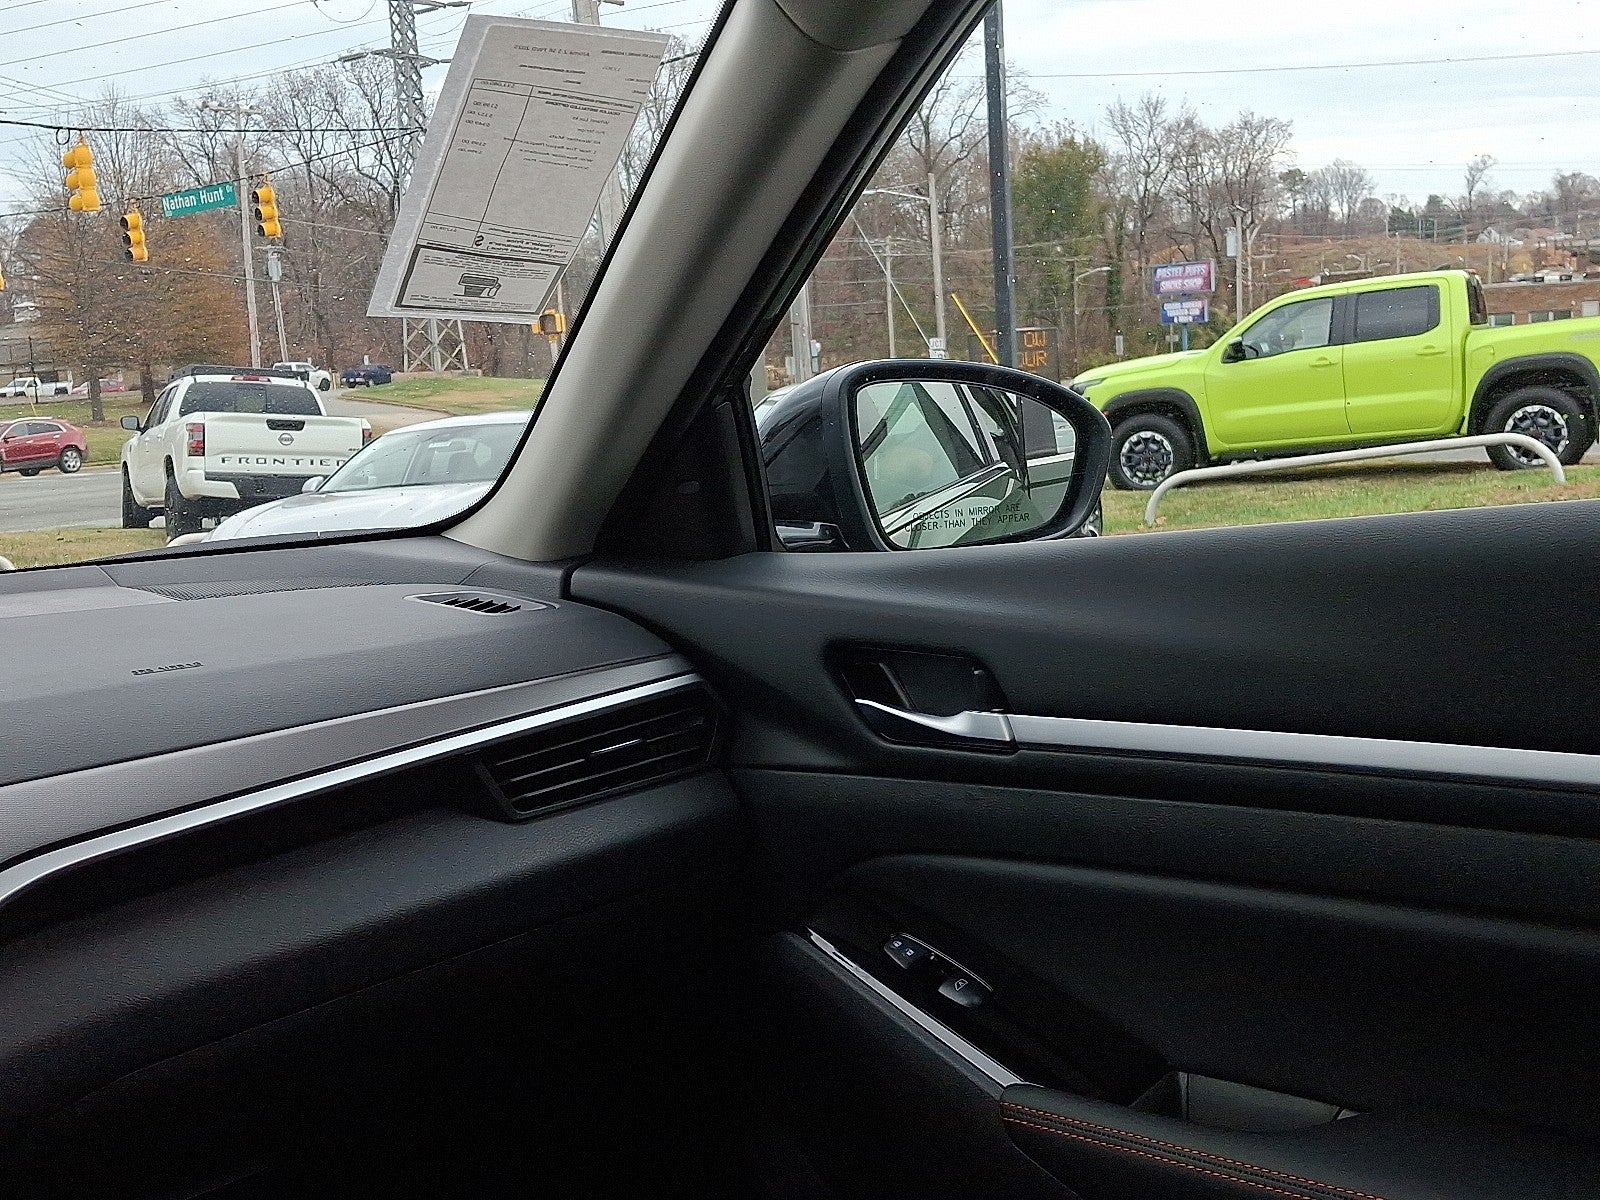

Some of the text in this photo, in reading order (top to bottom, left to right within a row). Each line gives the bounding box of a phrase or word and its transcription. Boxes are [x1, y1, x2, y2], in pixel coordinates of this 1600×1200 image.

[162, 194, 196, 211] Nathan
[200, 187, 224, 204] Hunt
[912, 502, 1021, 521] OBJECTS IN MIRROR ARE
[944, 518, 966, 529] THAN
[972, 516, 993, 526] THEY
[997, 512, 1030, 524] APPEAR
